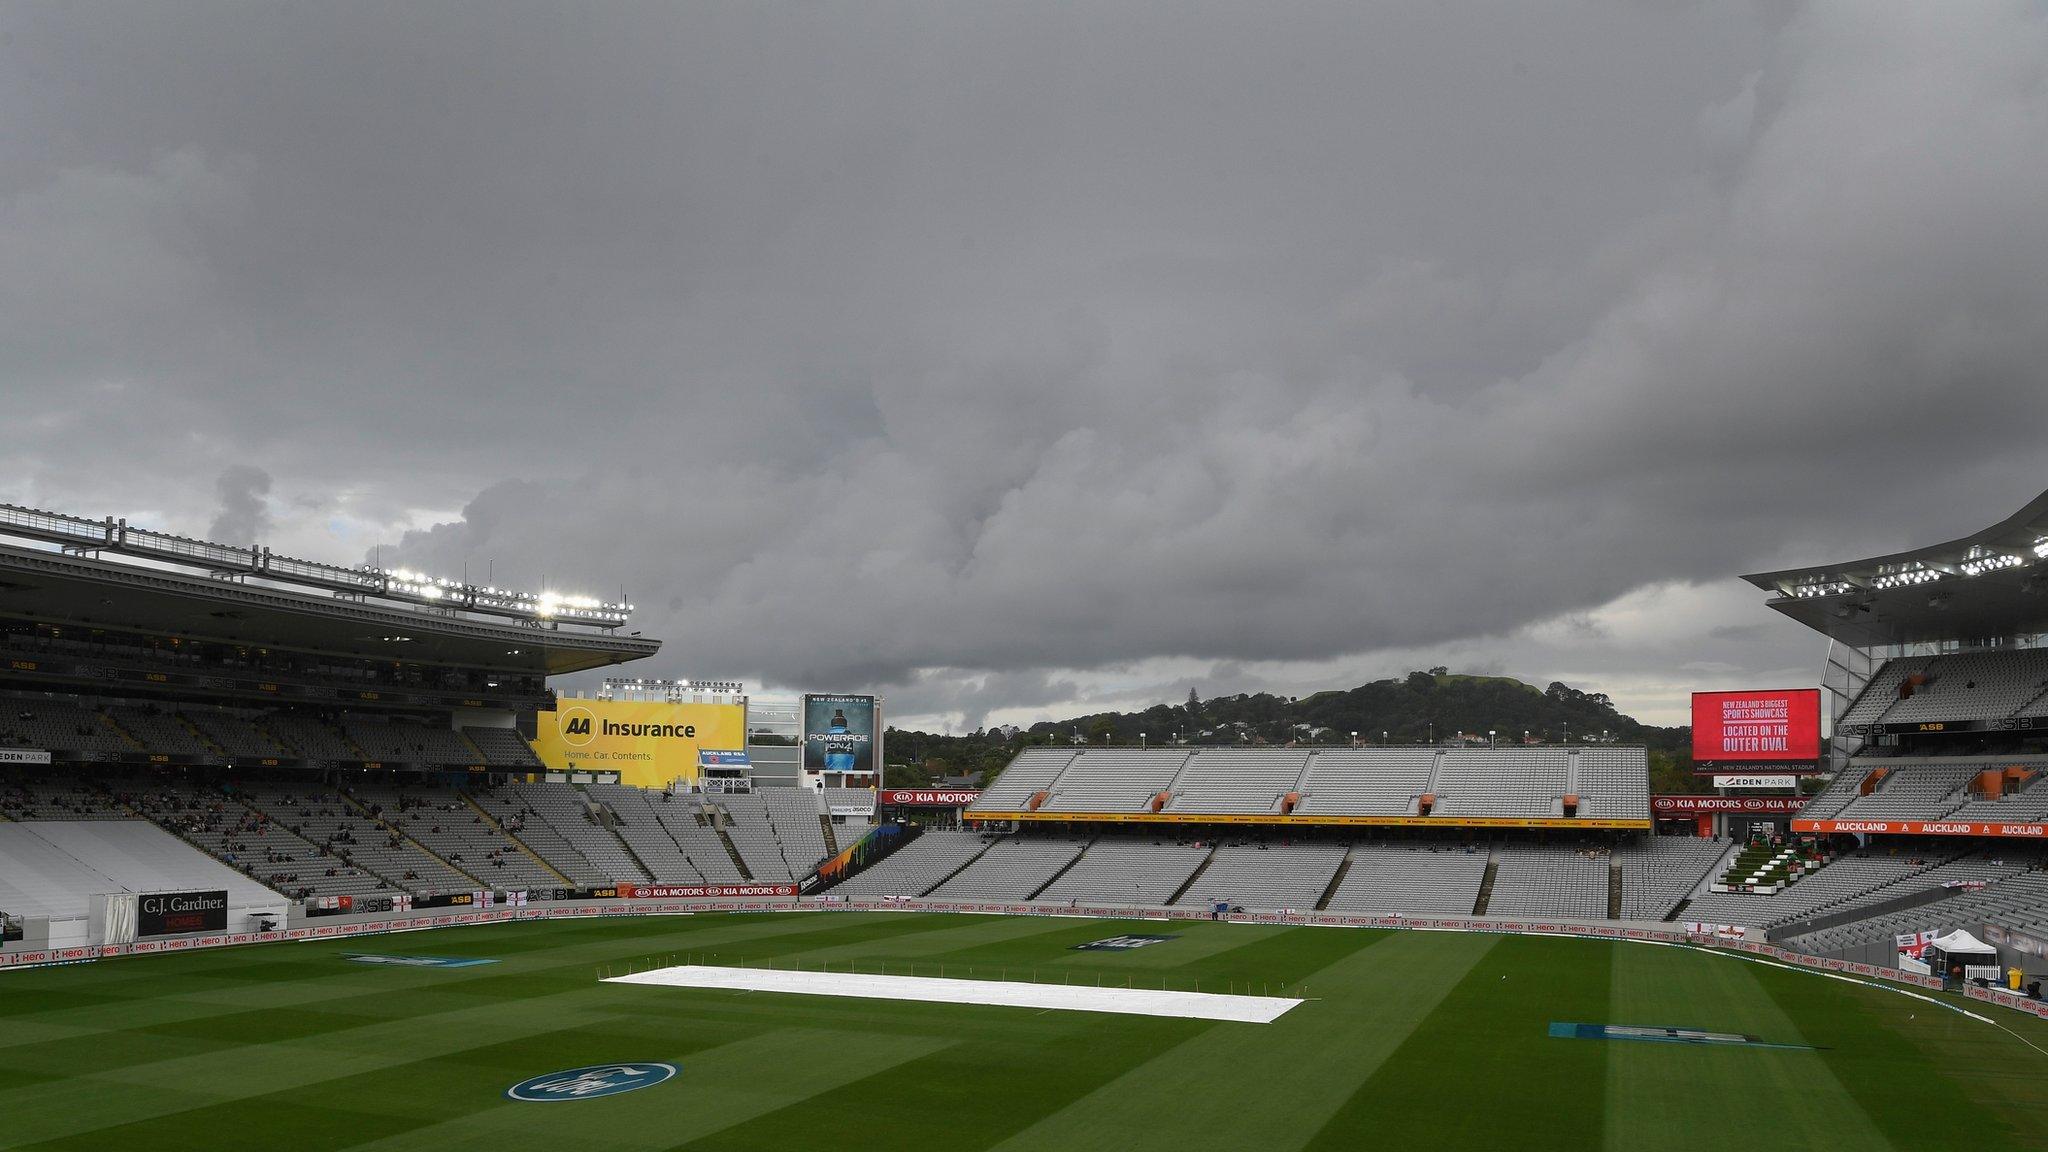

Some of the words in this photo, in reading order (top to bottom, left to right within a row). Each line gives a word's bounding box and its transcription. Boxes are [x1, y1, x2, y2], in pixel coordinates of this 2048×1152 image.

[12, 661, 38, 670] ASB
[145, 673, 168, 682] ASB
[1723, 701, 1735, 709] NEW
[1735, 700, 1765, 709] ZEALAND'S
[1765, 699, 1788, 708] BIGGEST
[1723, 709, 1750, 719] SPORTS
[1750, 708, 1788, 718] SHOWCASE
[566, 717, 590, 735] AA
[603, 719, 696, 738] Insurance
[1919, 723, 1944, 732] ASB
[1986, 717, 2034, 731] ASB
[1723, 726, 1758, 737] LOCATED
[1760, 725, 1771, 736] ON
[1774, 724, 1788, 735] THE
[1839, 723, 1886, 736] ASB
[809, 734, 869, 742] POWERADE
[1723, 738, 1759, 752] OUTER
[1761, 737, 1788, 751] OVAL
[26, 754, 50, 762] PARK
[564, 751, 591, 760] Home.
[594, 752, 609, 761] Car.
[612, 751, 653, 761] Contents.
[1736, 778, 1762, 786] EDEN
[916, 793, 934, 802] KIA
[936, 793, 979, 803] MOTORS
[1677, 799, 1693, 808] KIA
[1697, 799, 1741, 808] MOTORS
[1766, 800, 1784, 809] KIA
[1788, 799, 1809, 809] MOT
[1835, 822, 1888, 831] AUCKLAND
[1922, 824, 1971, 833] AUCKLAND
[2001, 825, 2043, 835] AUCKLAND
[528, 888, 569, 903] ASB
[594, 889, 616, 897] ASB
[653, 889, 668, 897] KIA
[669, 888, 704, 897] MOTORS
[723, 887, 738, 896] KIA
[739, 887, 774, 896] MOTORS
[451, 895, 472, 905] ASB
[144, 898, 167, 916] G.J.
[171, 896, 224, 912] Gardner.
[353, 897, 392, 914] ASB
